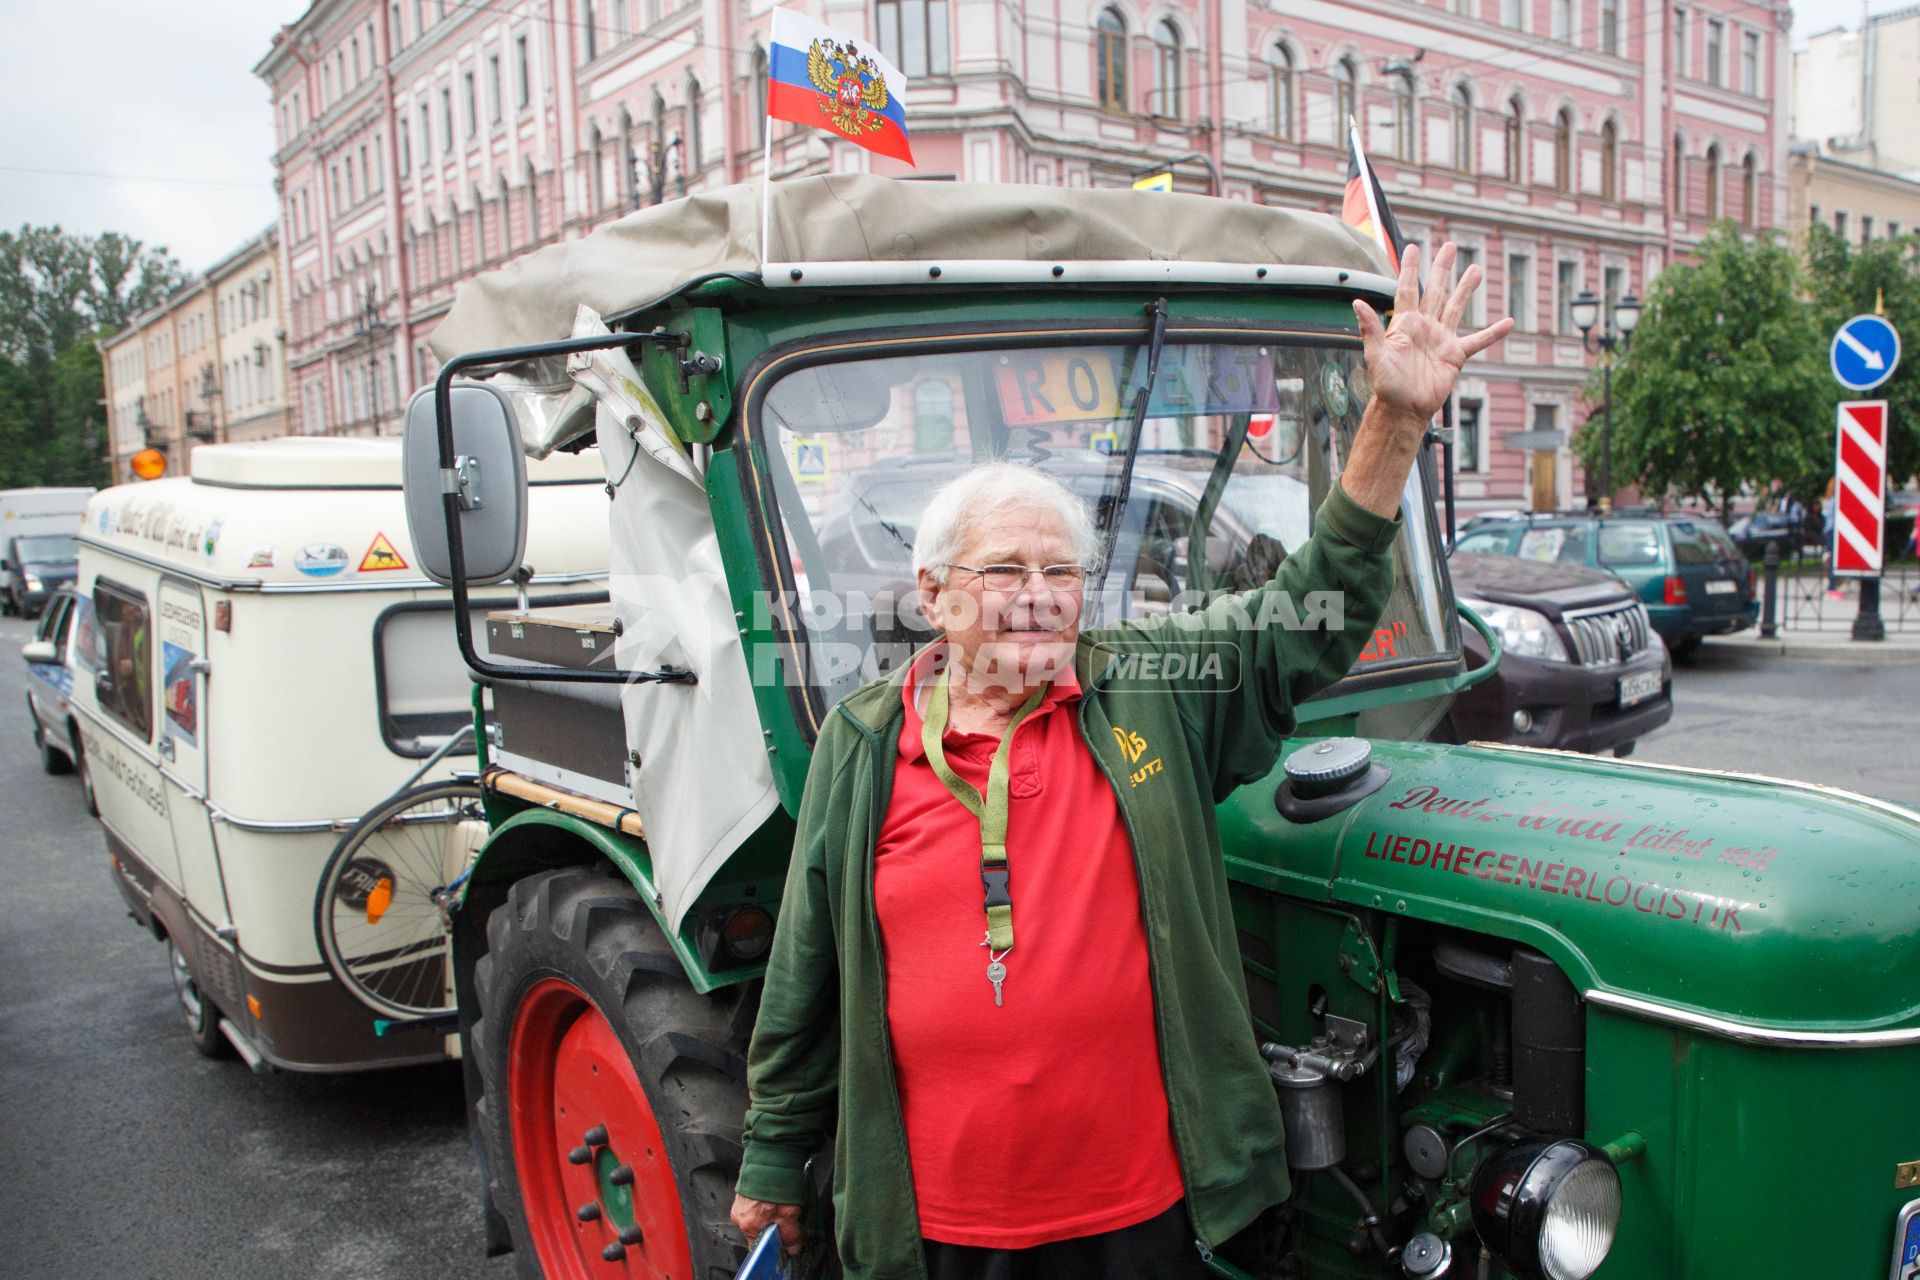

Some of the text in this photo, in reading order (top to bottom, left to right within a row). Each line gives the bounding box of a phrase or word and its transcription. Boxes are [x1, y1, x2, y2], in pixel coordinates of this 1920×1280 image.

[1016, 352, 1260, 415] ROERT
[1388, 785, 1782, 872] Deutz-Willi fährt mit
[1364, 831, 1751, 934] LIEDHEGENERLOGISTIK
